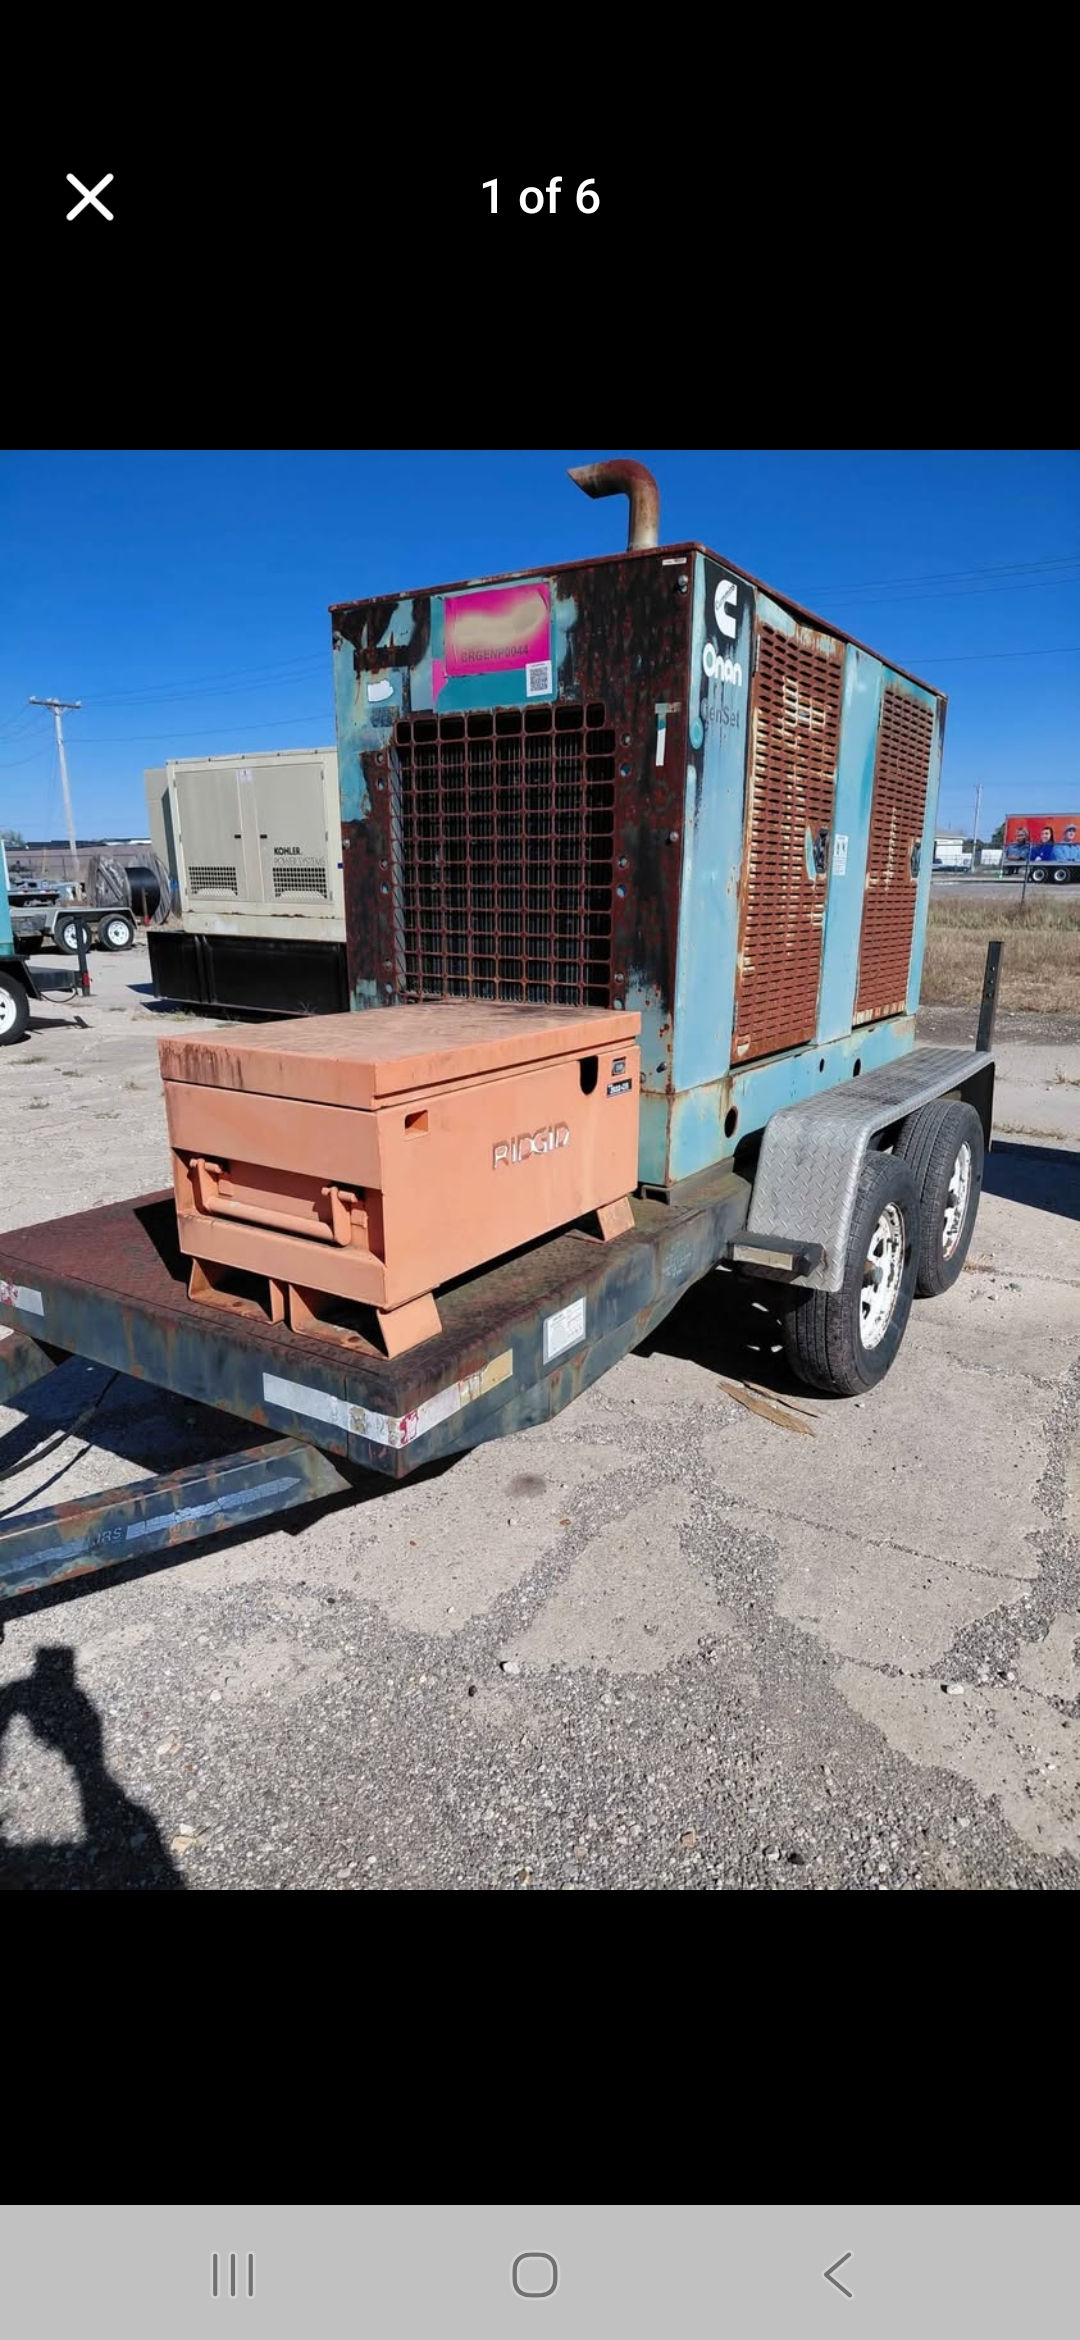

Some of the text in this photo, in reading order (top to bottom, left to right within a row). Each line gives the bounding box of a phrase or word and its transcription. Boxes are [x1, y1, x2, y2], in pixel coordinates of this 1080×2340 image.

[702, 642, 743, 687] Onan
[273, 847, 301, 856] KOHLER
[492, 1120, 571, 1170] RIDGID
